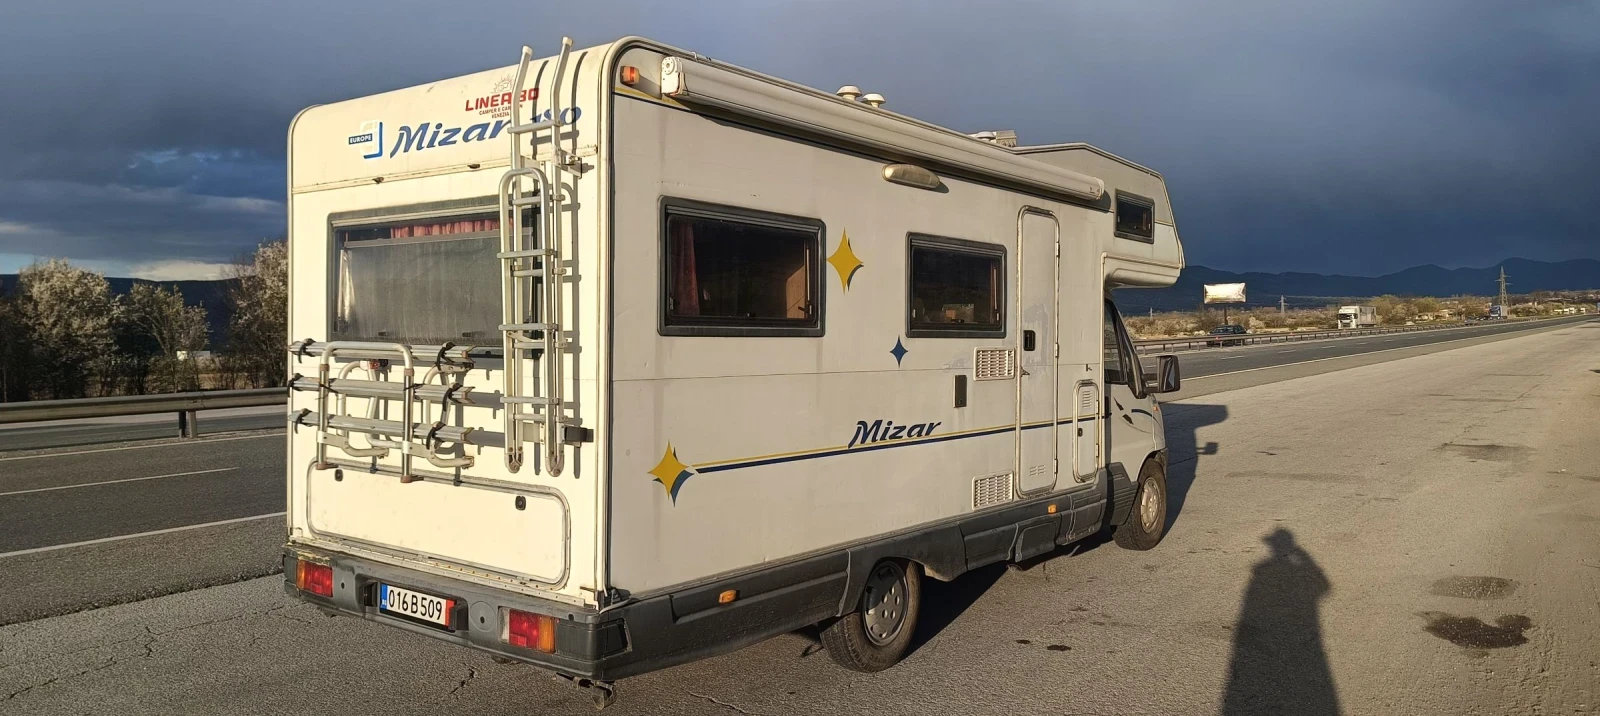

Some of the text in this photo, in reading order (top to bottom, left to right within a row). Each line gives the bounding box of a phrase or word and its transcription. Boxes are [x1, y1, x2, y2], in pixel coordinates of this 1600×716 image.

[479, 108, 498, 116] CAMPER
[350, 134, 371, 144] EUROPE
[390, 120, 511, 158] Mizar
[848, 420, 942, 449] Mizar
